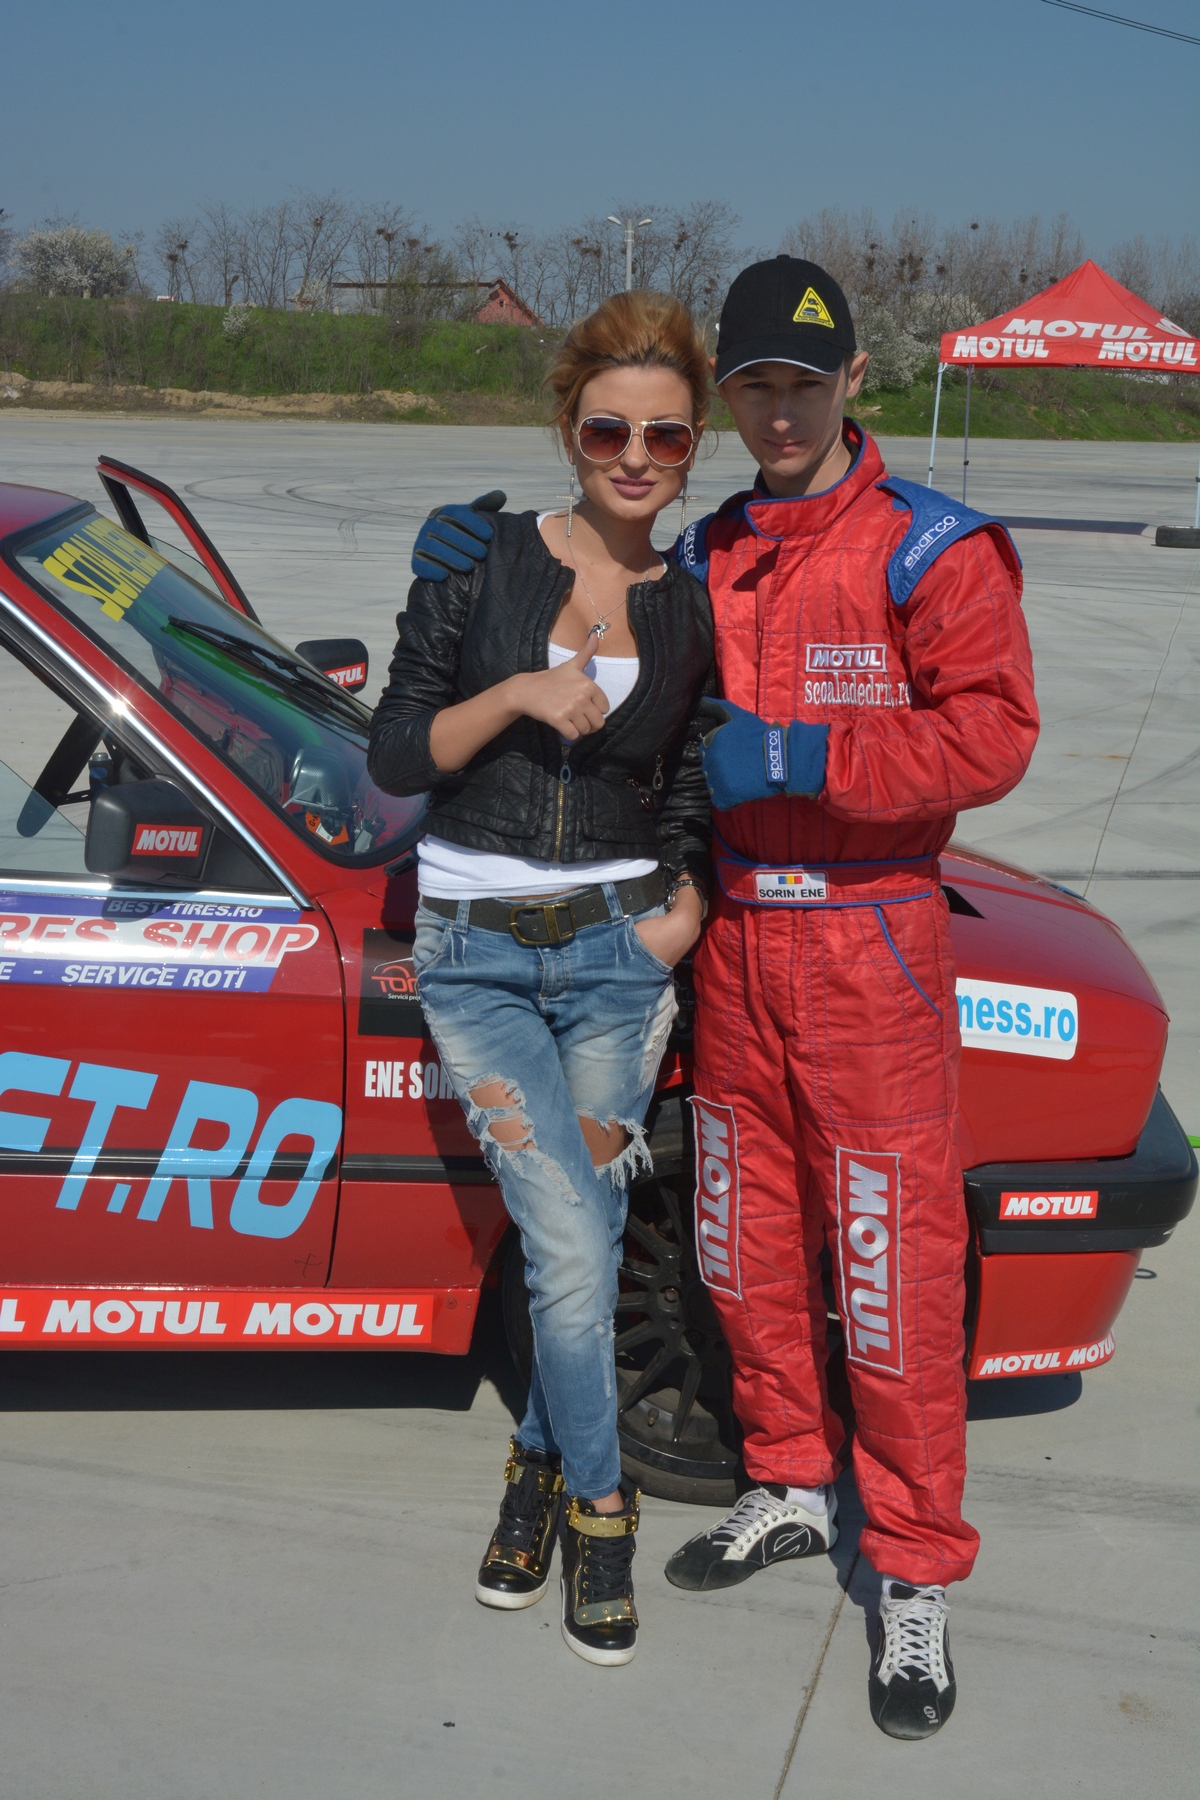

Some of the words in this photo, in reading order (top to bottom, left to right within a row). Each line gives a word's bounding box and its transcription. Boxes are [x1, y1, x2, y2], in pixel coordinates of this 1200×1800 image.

[1002, 318, 1152, 339] MOTUL
[952, 335, 1049, 358] MOTUL
[1098, 341, 1197, 365] MOTUL
[905, 515, 956, 568] sparco
[811, 650, 882, 668] MOTUL
[769, 730, 783, 779] sparco
[136, 829, 198, 852] MOTUL
[759, 889, 795, 898] SORIN
[800, 888, 825, 898] ENE
[106, 900, 263, 918] BEST-TIRES.RO
[143, 919, 317, 963] SHOP
[61, 964, 177, 986] SERVICE
[956, 994, 1076, 1042] ness.ro
[365, 1061, 404, 1098] ENE
[699, 1105, 731, 1279] MOTUL
[1004, 1196, 1093, 1216] MOTUL
[848, 1159, 890, 1355] MOTUL
[42, 1300, 227, 1334] MOTUL
[243, 1303, 424, 1336] MOTUL
[979, 1352, 1060, 1376] MOTUL
